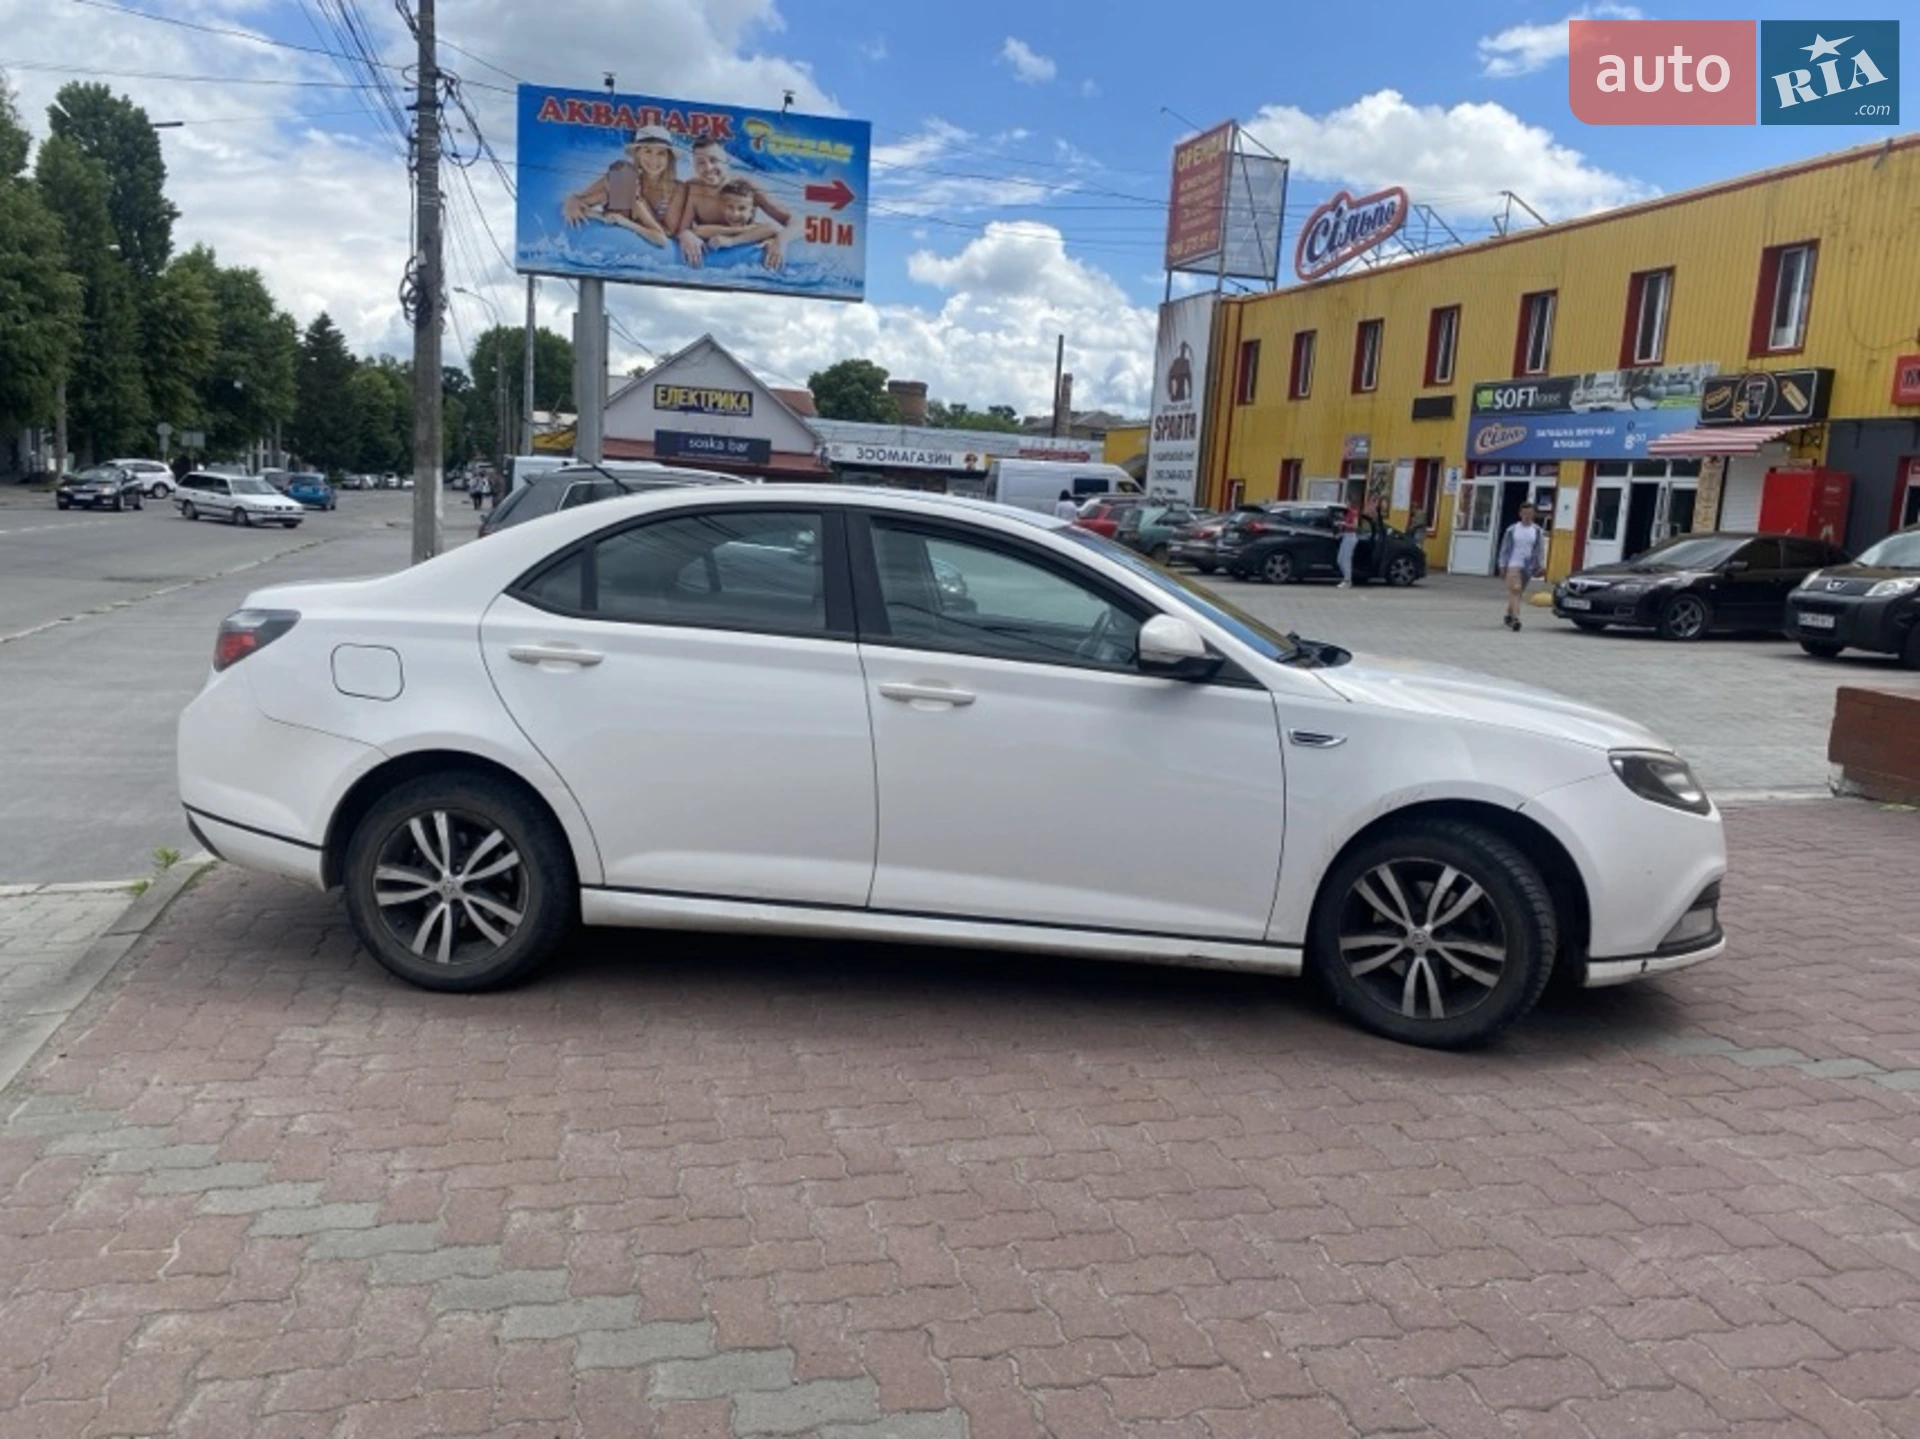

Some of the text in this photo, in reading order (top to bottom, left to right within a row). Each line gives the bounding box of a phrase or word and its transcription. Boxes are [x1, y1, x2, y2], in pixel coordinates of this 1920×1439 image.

[538, 97, 735, 139] АКВАПАРК
[804, 216, 832, 244] 50
[1306, 200, 1396, 262] Сільпо
[656, 386, 750, 412] ЕЛЕКТРИКА
[1494, 386, 1538, 410] SOFT
[727, 440, 750, 453] bar
